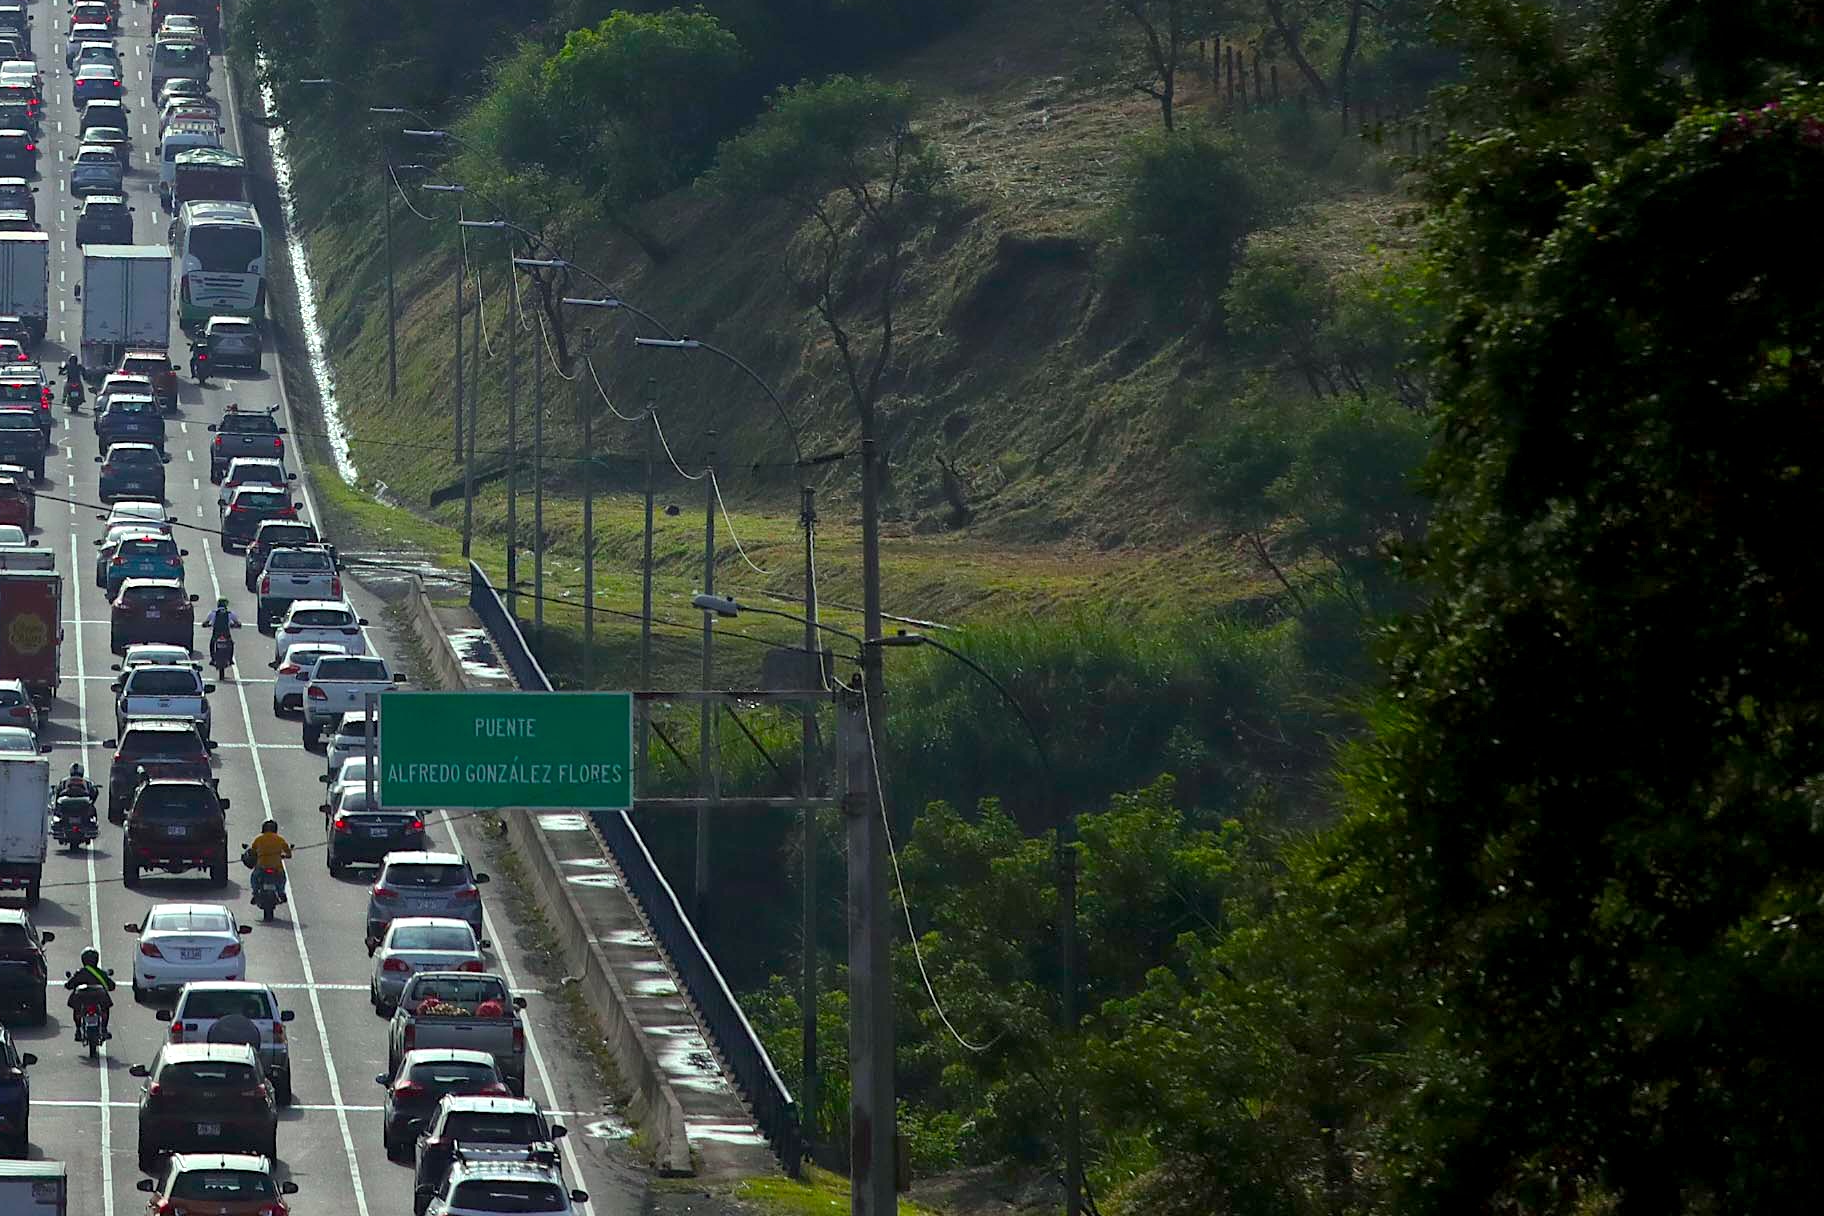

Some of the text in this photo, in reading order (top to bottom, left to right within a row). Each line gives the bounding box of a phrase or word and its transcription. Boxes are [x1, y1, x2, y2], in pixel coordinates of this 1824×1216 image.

[475, 718, 536, 737] PUENTE
[388, 755, 622, 784] ALFREDO GONZÁLEZ FLORES
